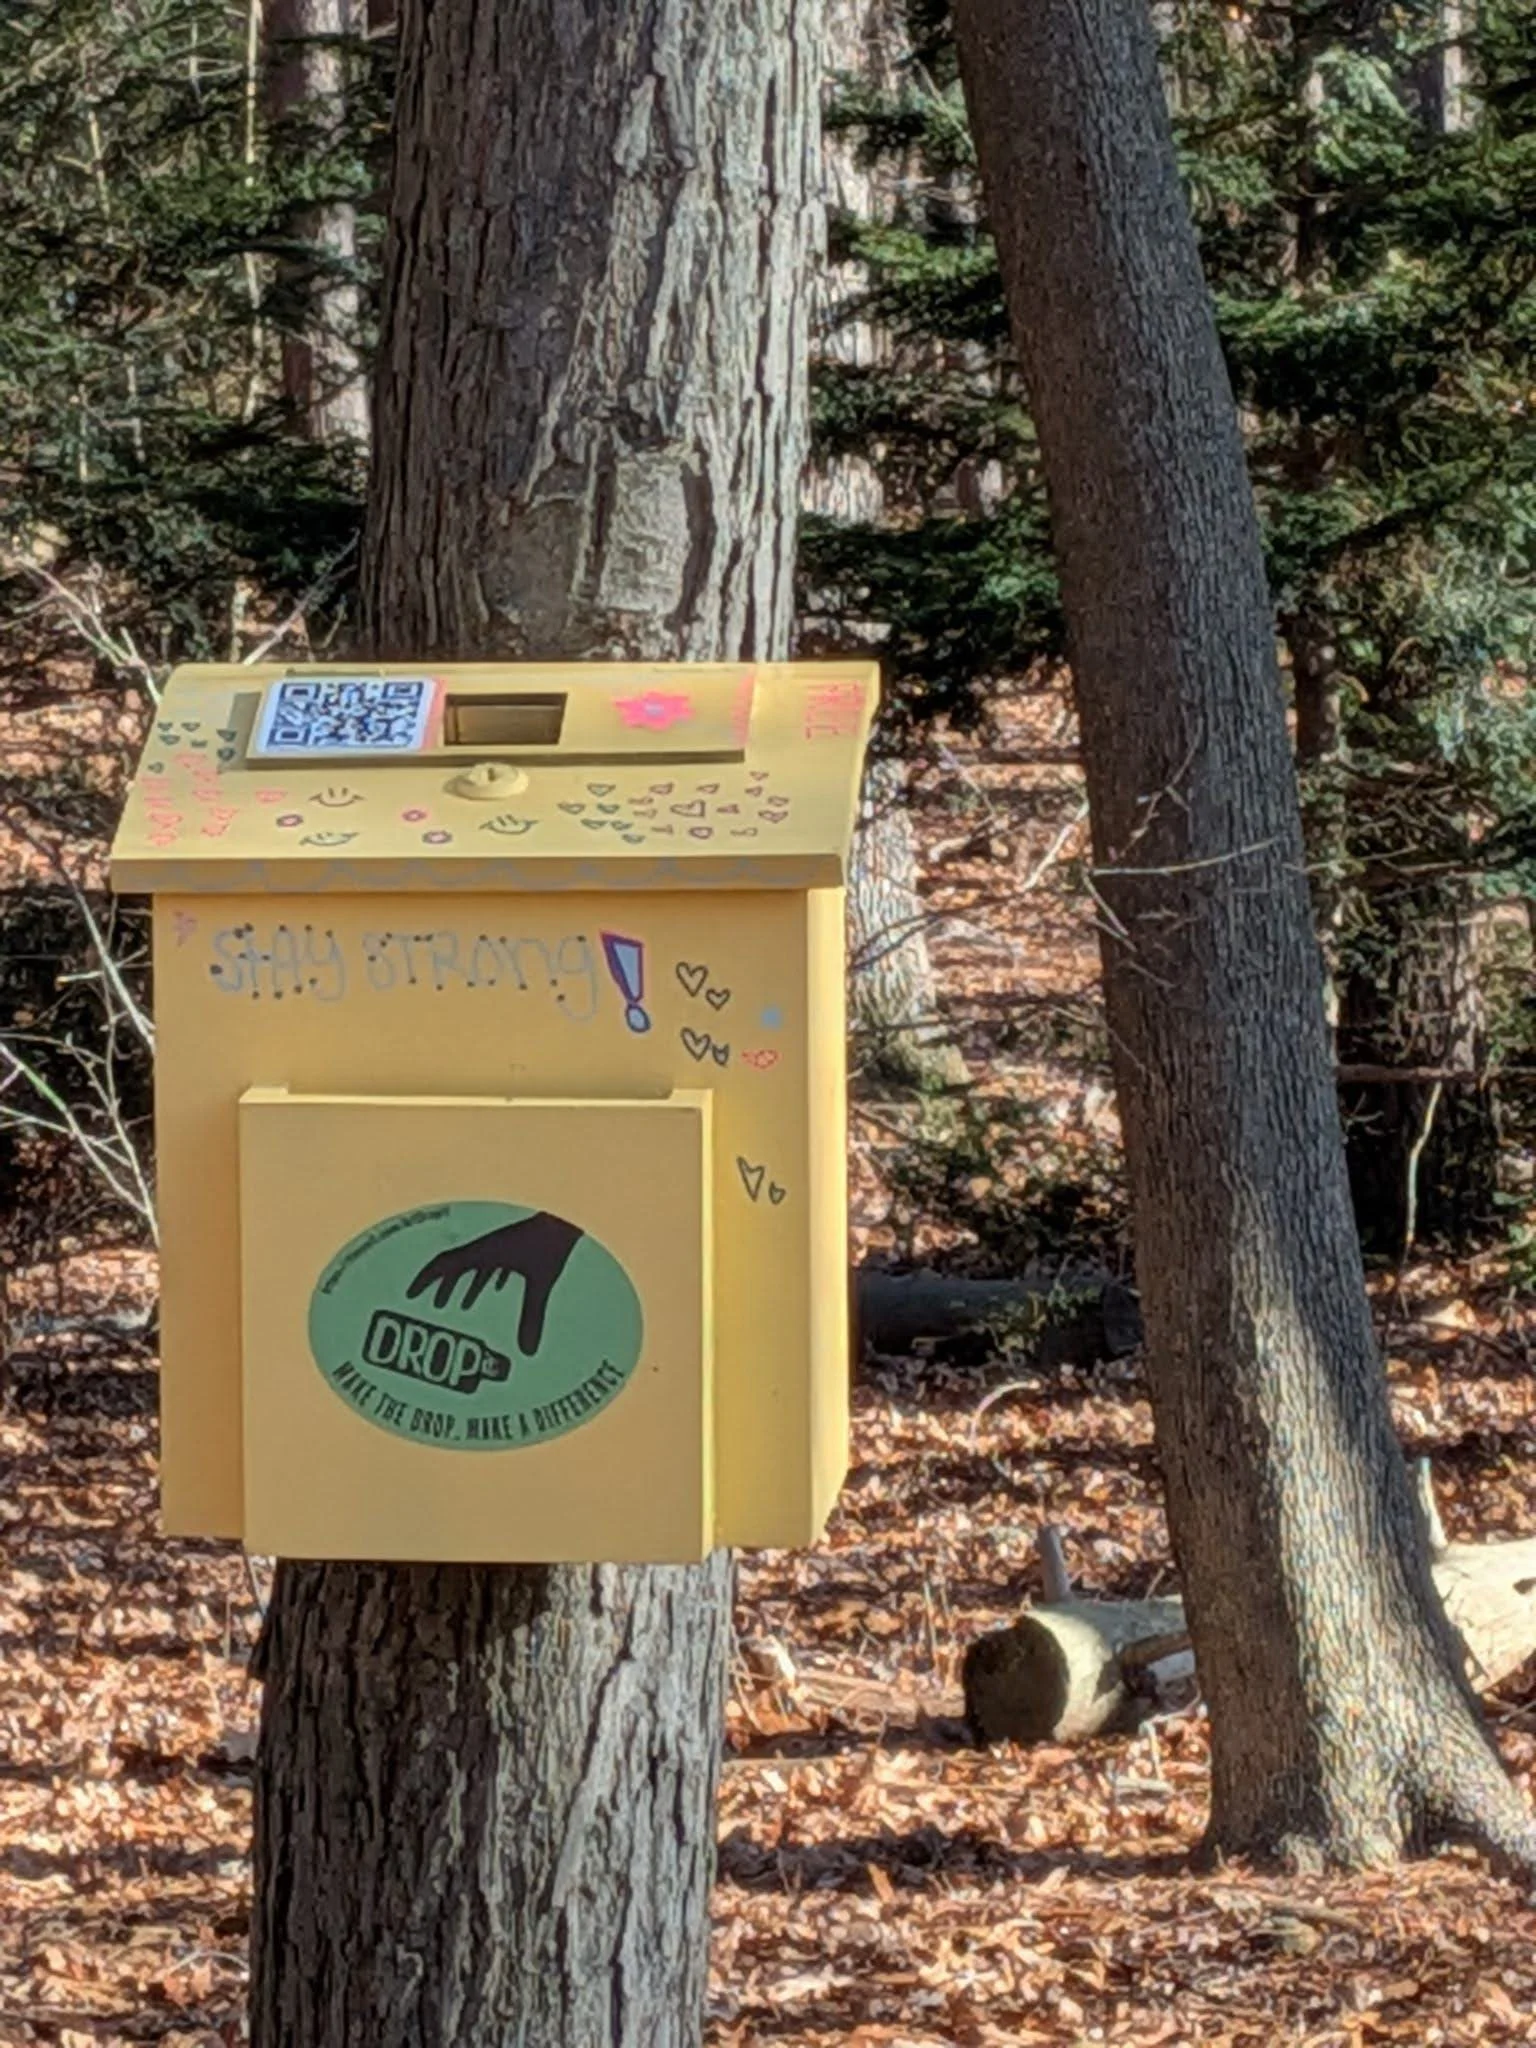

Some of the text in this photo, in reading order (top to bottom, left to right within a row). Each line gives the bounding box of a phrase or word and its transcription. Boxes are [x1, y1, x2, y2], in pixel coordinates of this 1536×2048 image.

[368, 1315, 483, 1386] DROP
[331, 1360, 377, 1407] MAKE
[374, 1392, 408, 1427] THE
[466, 1414, 513, 1440] MAKE
[518, 1412, 531, 1437] A
[532, 1358, 625, 1432] DIFFERENCE
